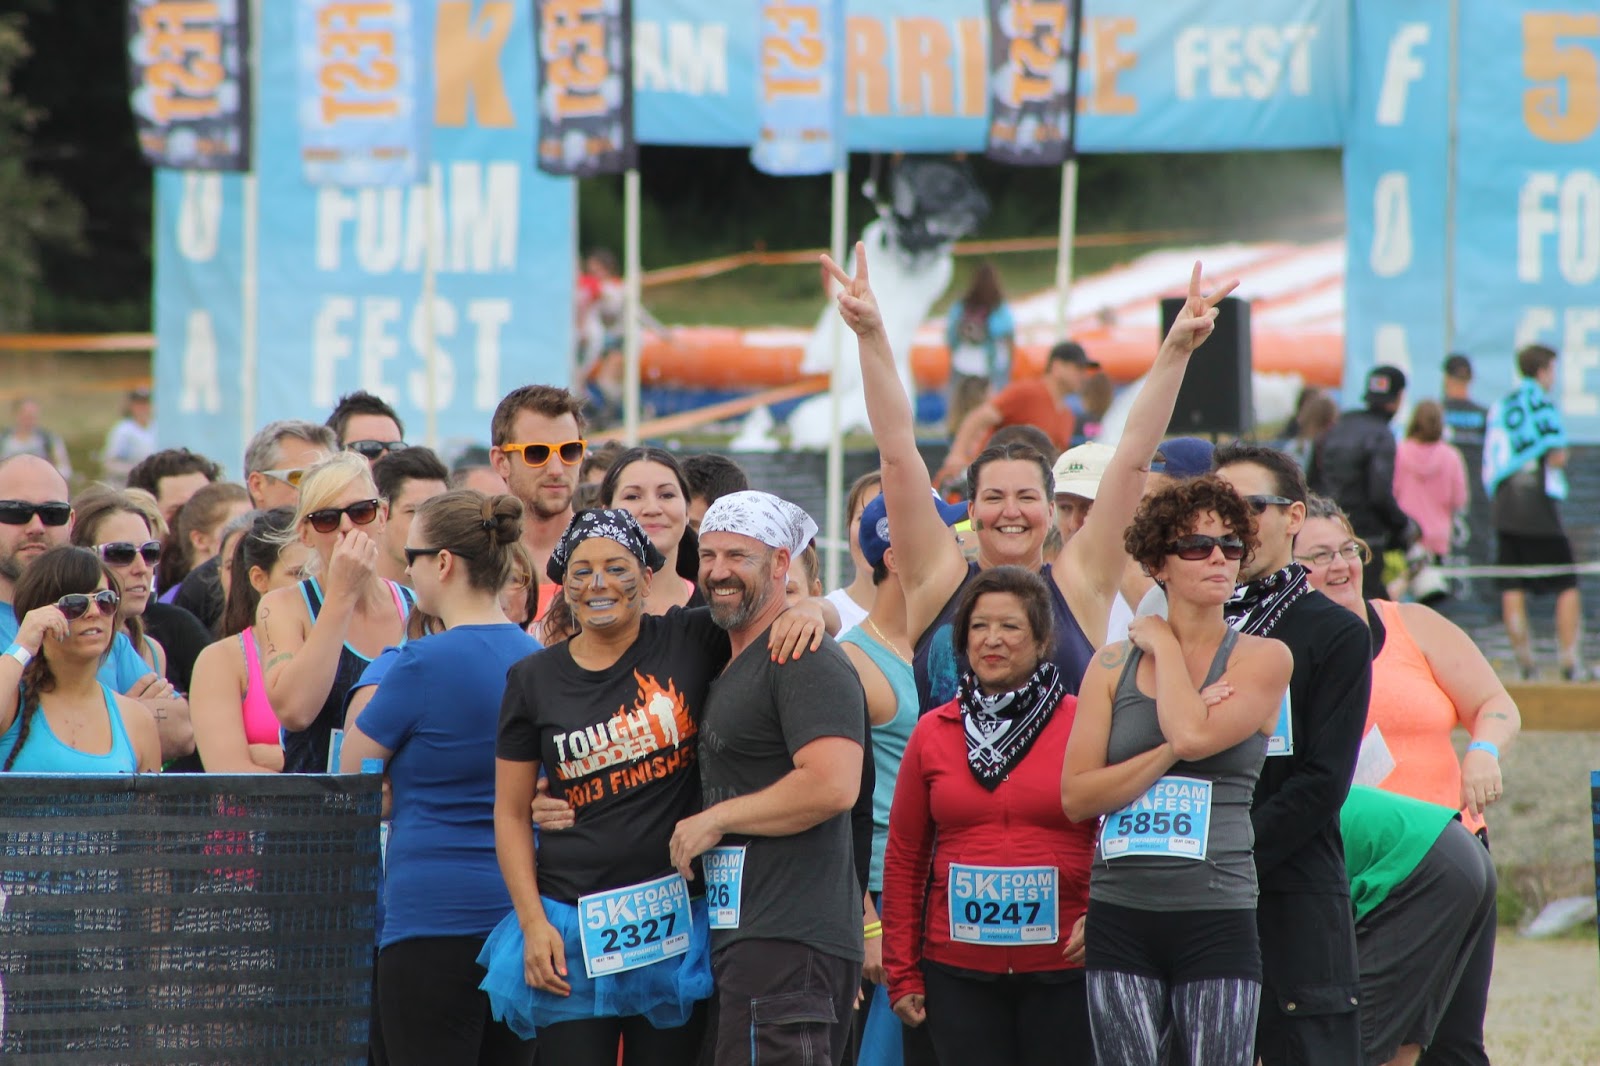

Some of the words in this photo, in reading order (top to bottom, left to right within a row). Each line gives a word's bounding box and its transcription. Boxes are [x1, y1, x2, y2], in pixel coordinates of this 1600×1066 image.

[1174, 25, 1318, 100] FEST
[317, 162, 520, 273] FOAM
[312, 296, 513, 412] FEST
[553, 709, 651, 762] TOUGH
[558, 733, 659, 779] MUDDER
[564, 777, 604, 809] 2013
[609, 745, 697, 794] FINISHE
[1155, 783, 1206, 800] FOAM
[1154, 797, 1205, 814] FEST
[1117, 812, 1192, 836] 5856
[708, 854, 740, 868] FOAM
[708, 868, 738, 882] FEST
[955, 872, 1000, 900] 5K
[1001, 873, 1052, 887] FOAM
[633, 881, 683, 906] FOAM
[1001, 887, 1052, 901] FEST
[586, 894, 637, 930] 5K
[637, 894, 683, 921] FEST
[965, 900, 1041, 925] 0247
[600, 912, 676, 953] 2327
